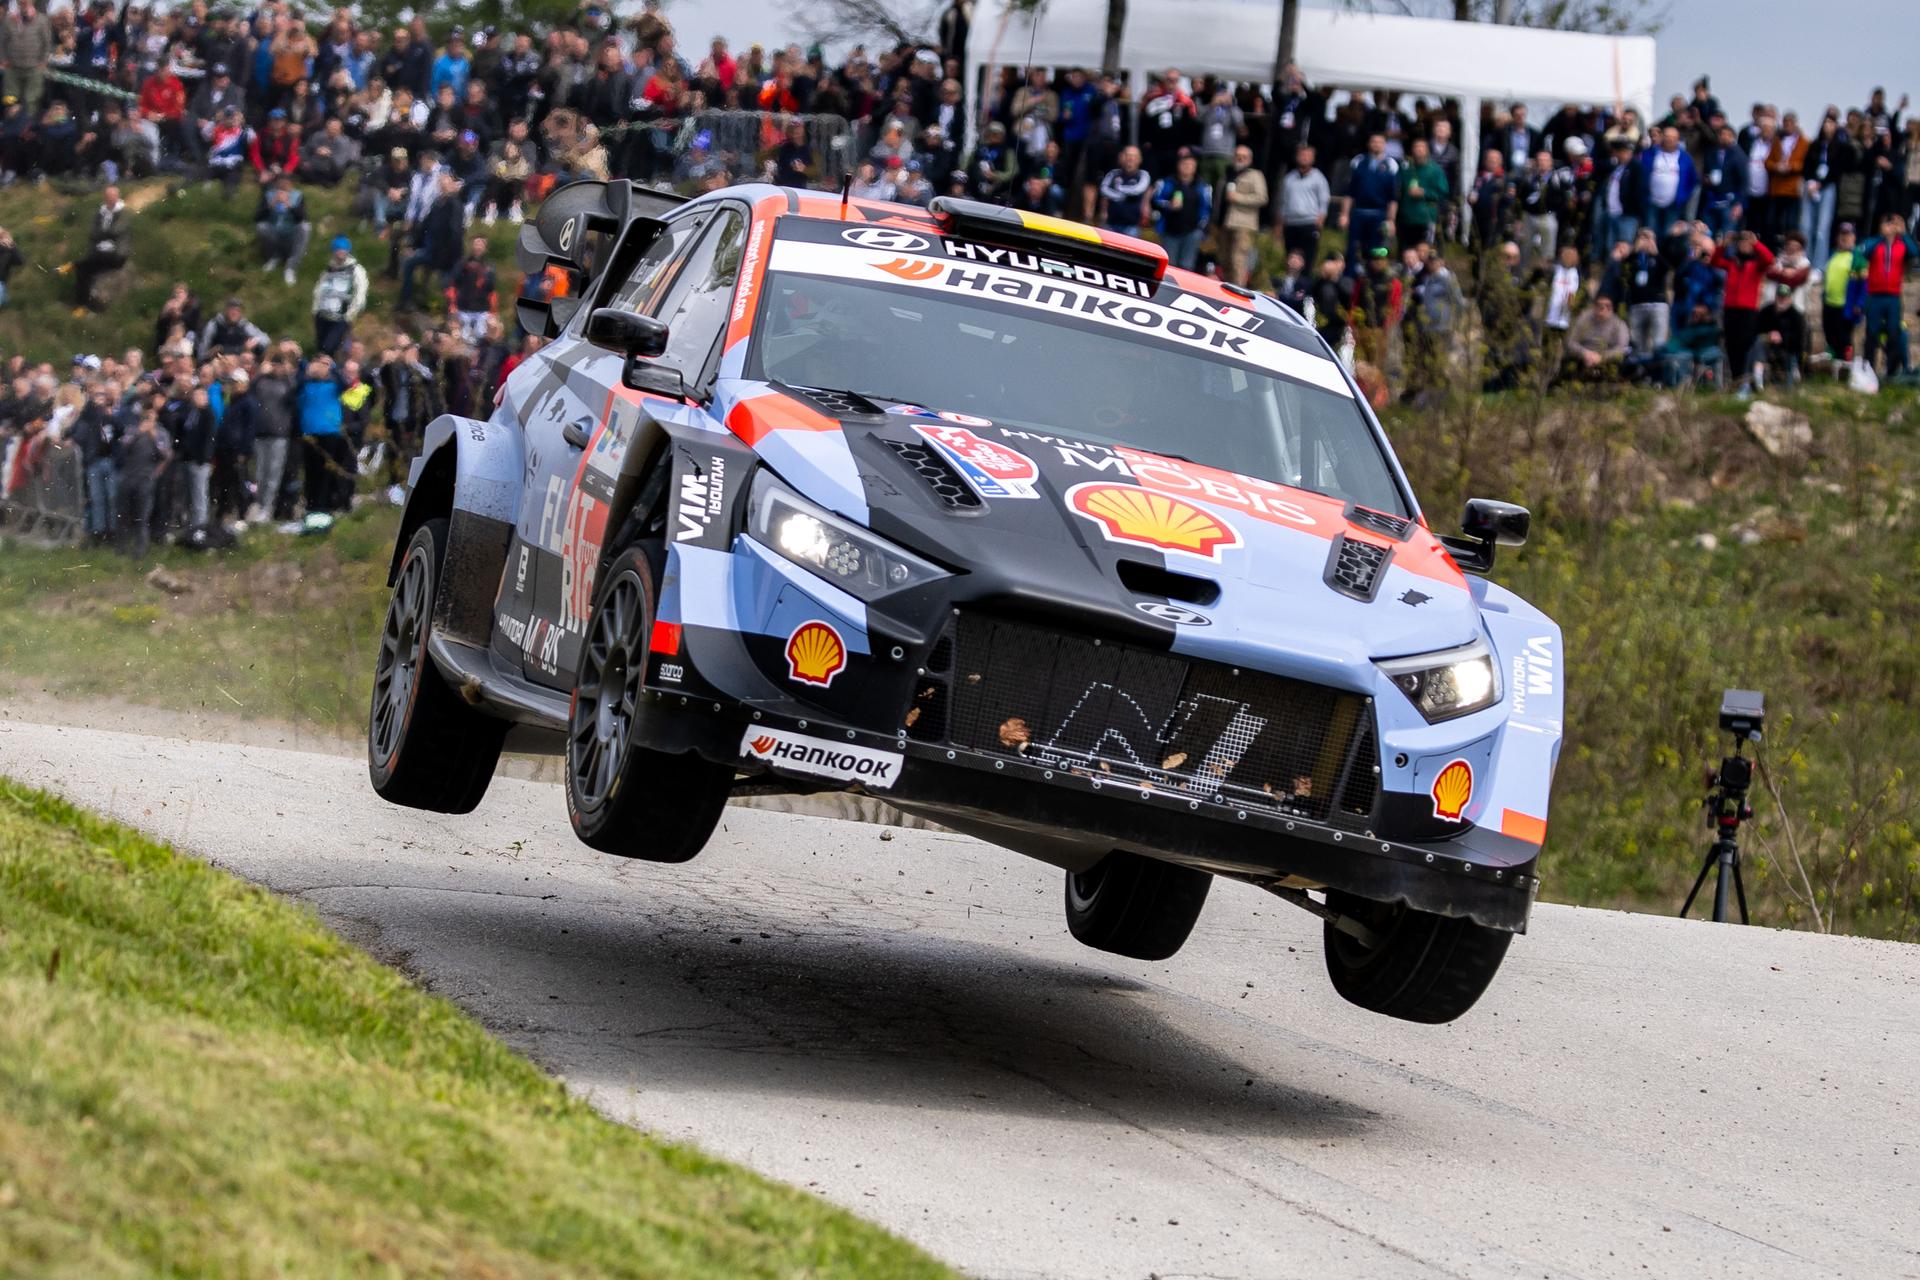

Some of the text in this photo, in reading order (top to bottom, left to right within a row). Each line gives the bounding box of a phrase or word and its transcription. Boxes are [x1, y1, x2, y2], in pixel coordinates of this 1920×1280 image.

[944, 240, 1151, 298] HYUNDAI
[1000, 428, 1184, 472] HYUNDAI
[709, 456, 725, 515] HYUNDAI
[1053, 445, 1317, 526] MOBIS
[1513, 656, 1526, 714] HYUNDAI
